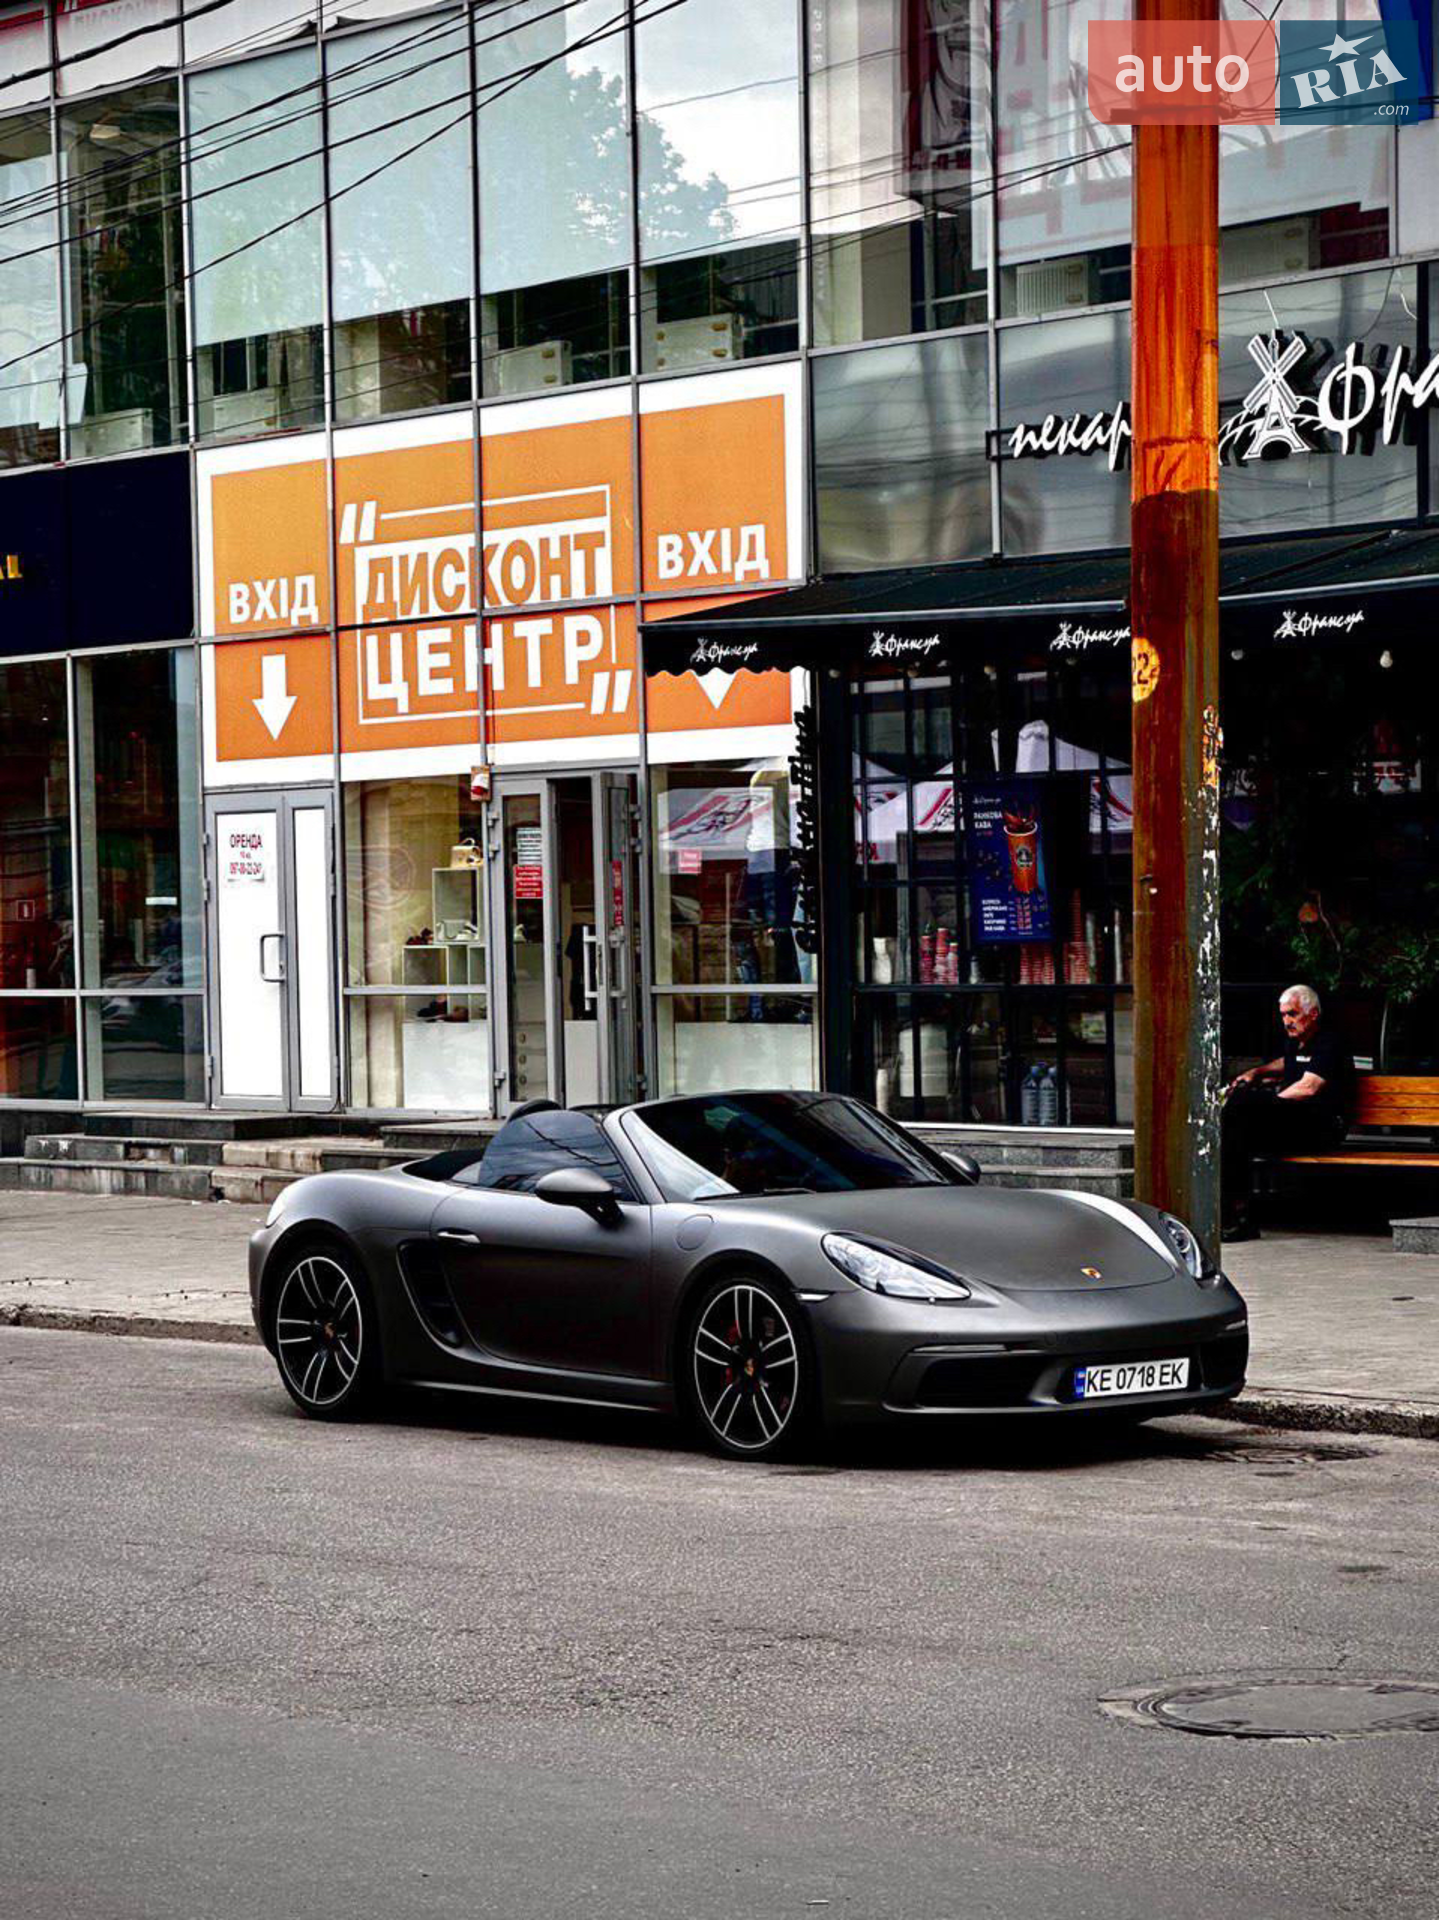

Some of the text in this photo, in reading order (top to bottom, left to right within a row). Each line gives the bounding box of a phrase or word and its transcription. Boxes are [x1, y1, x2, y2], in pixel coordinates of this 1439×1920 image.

[362, 530, 607, 623] ДИСКОНТ
[657, 524, 770, 582] ВХІД
[228, 574, 319, 626] ВХІД
[366, 614, 604, 714] ЦЕНТР
[230, 834, 263, 850] ОРЕНДА
[1086, 1369, 1113, 1393] KE
[1116, 1365, 1156, 1390] 0718
[1159, 1362, 1185, 1386] EK
